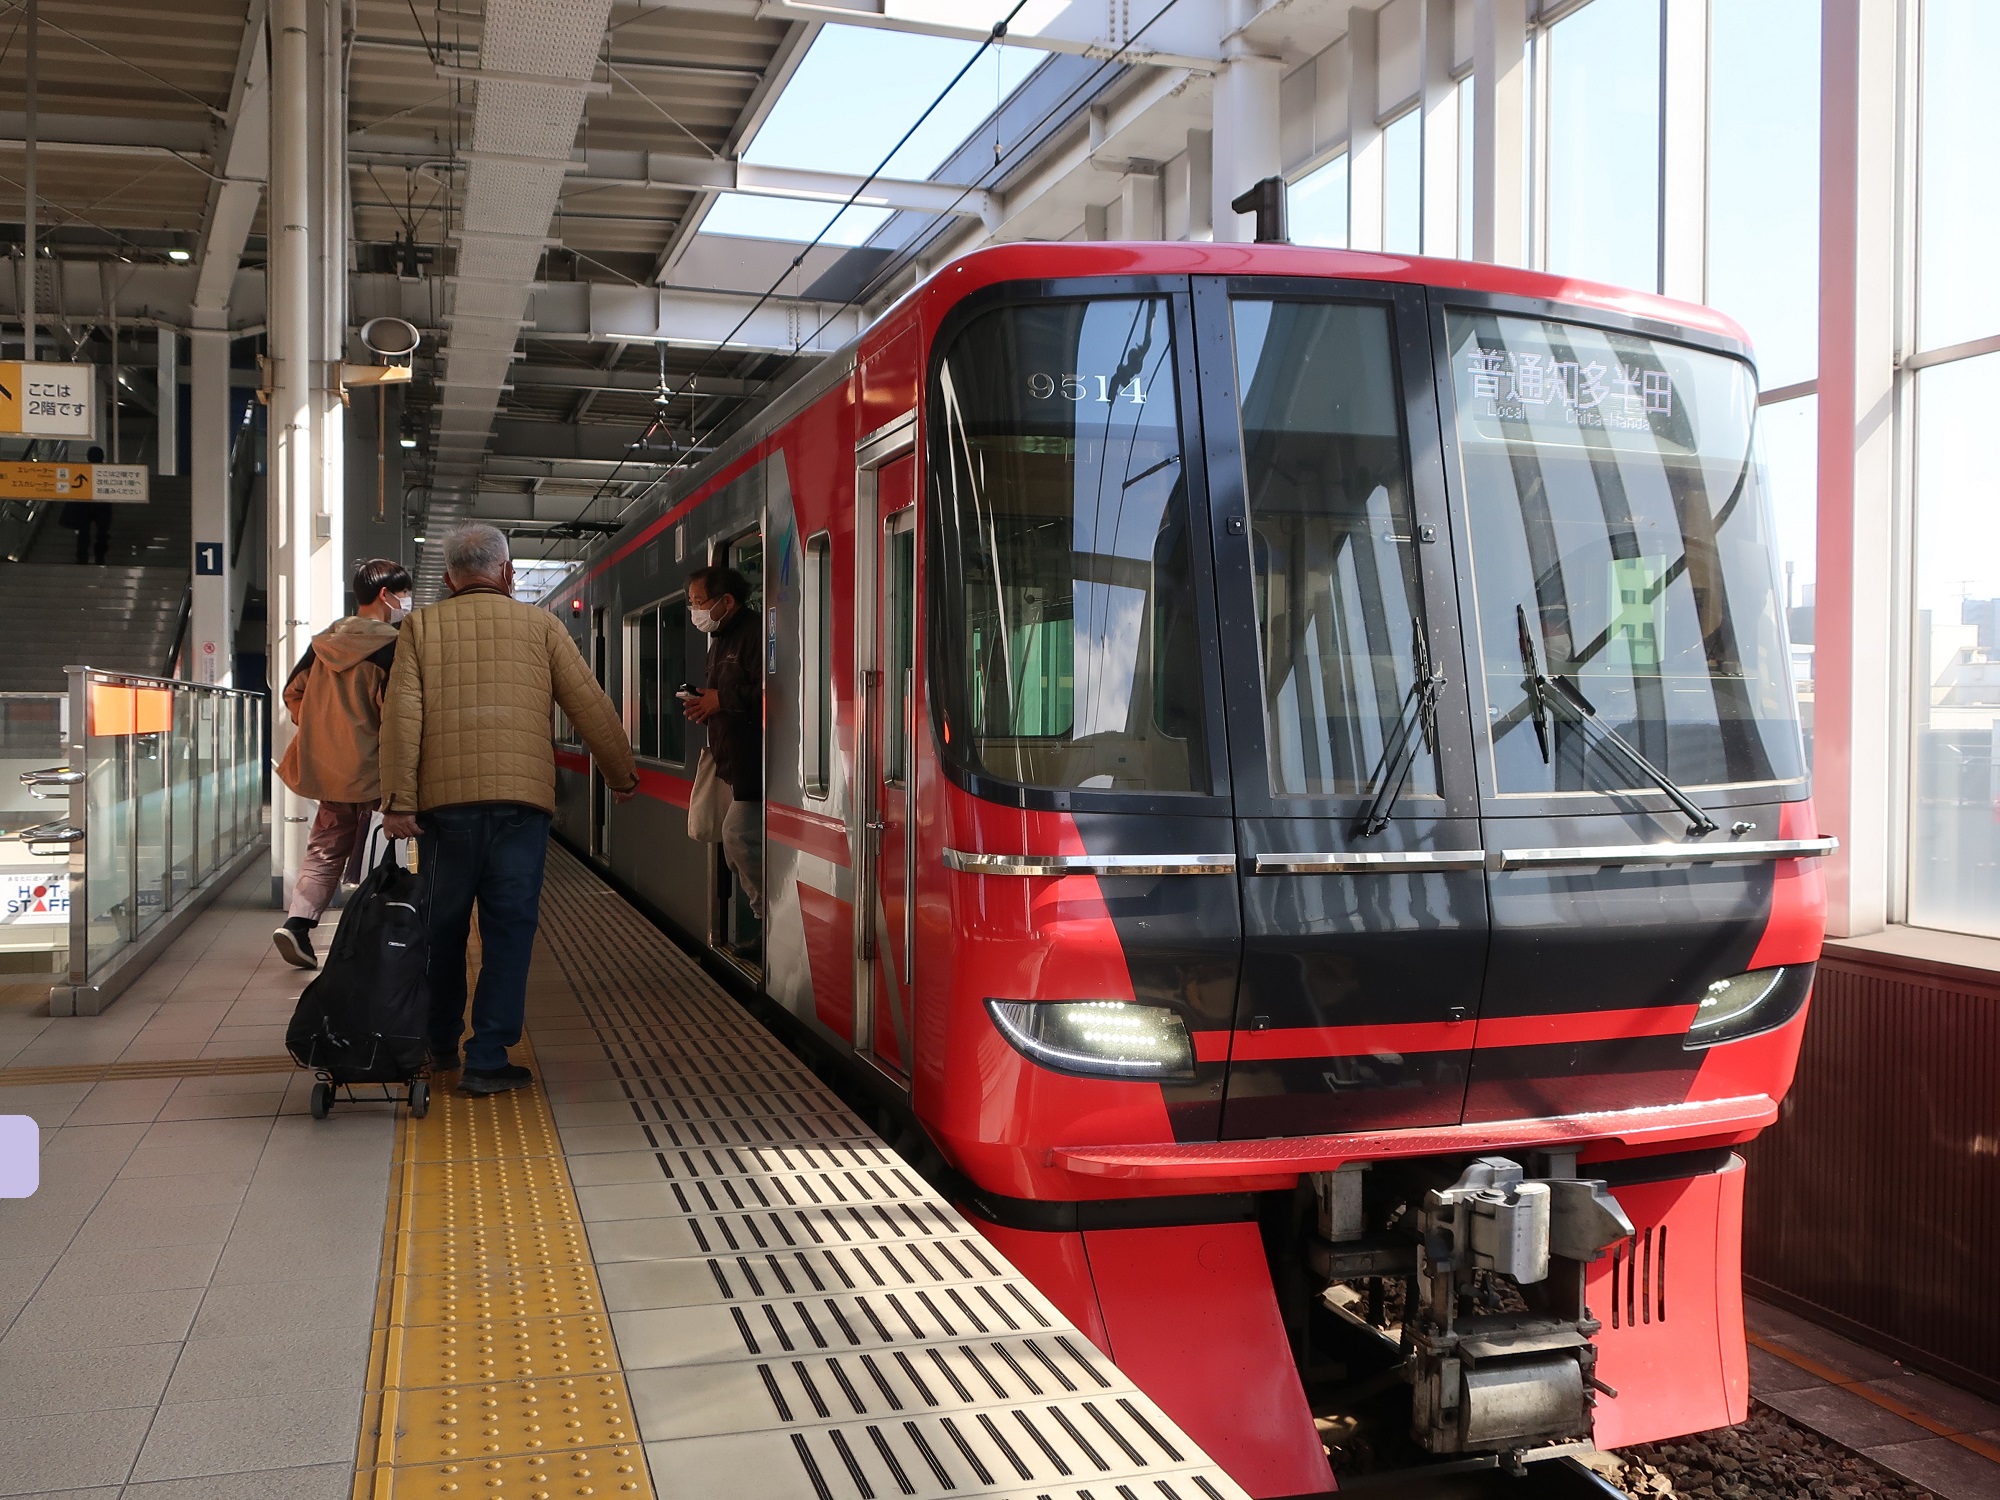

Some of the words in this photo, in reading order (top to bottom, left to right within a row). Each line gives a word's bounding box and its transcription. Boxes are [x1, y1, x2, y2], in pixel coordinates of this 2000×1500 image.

[29, 383, 71, 397] ここは
[1027, 373, 1147, 404] 9514
[29, 401, 86, 416] 2階です
[1487, 401, 1525, 420] Local
[202, 548, 214, 570] 1
